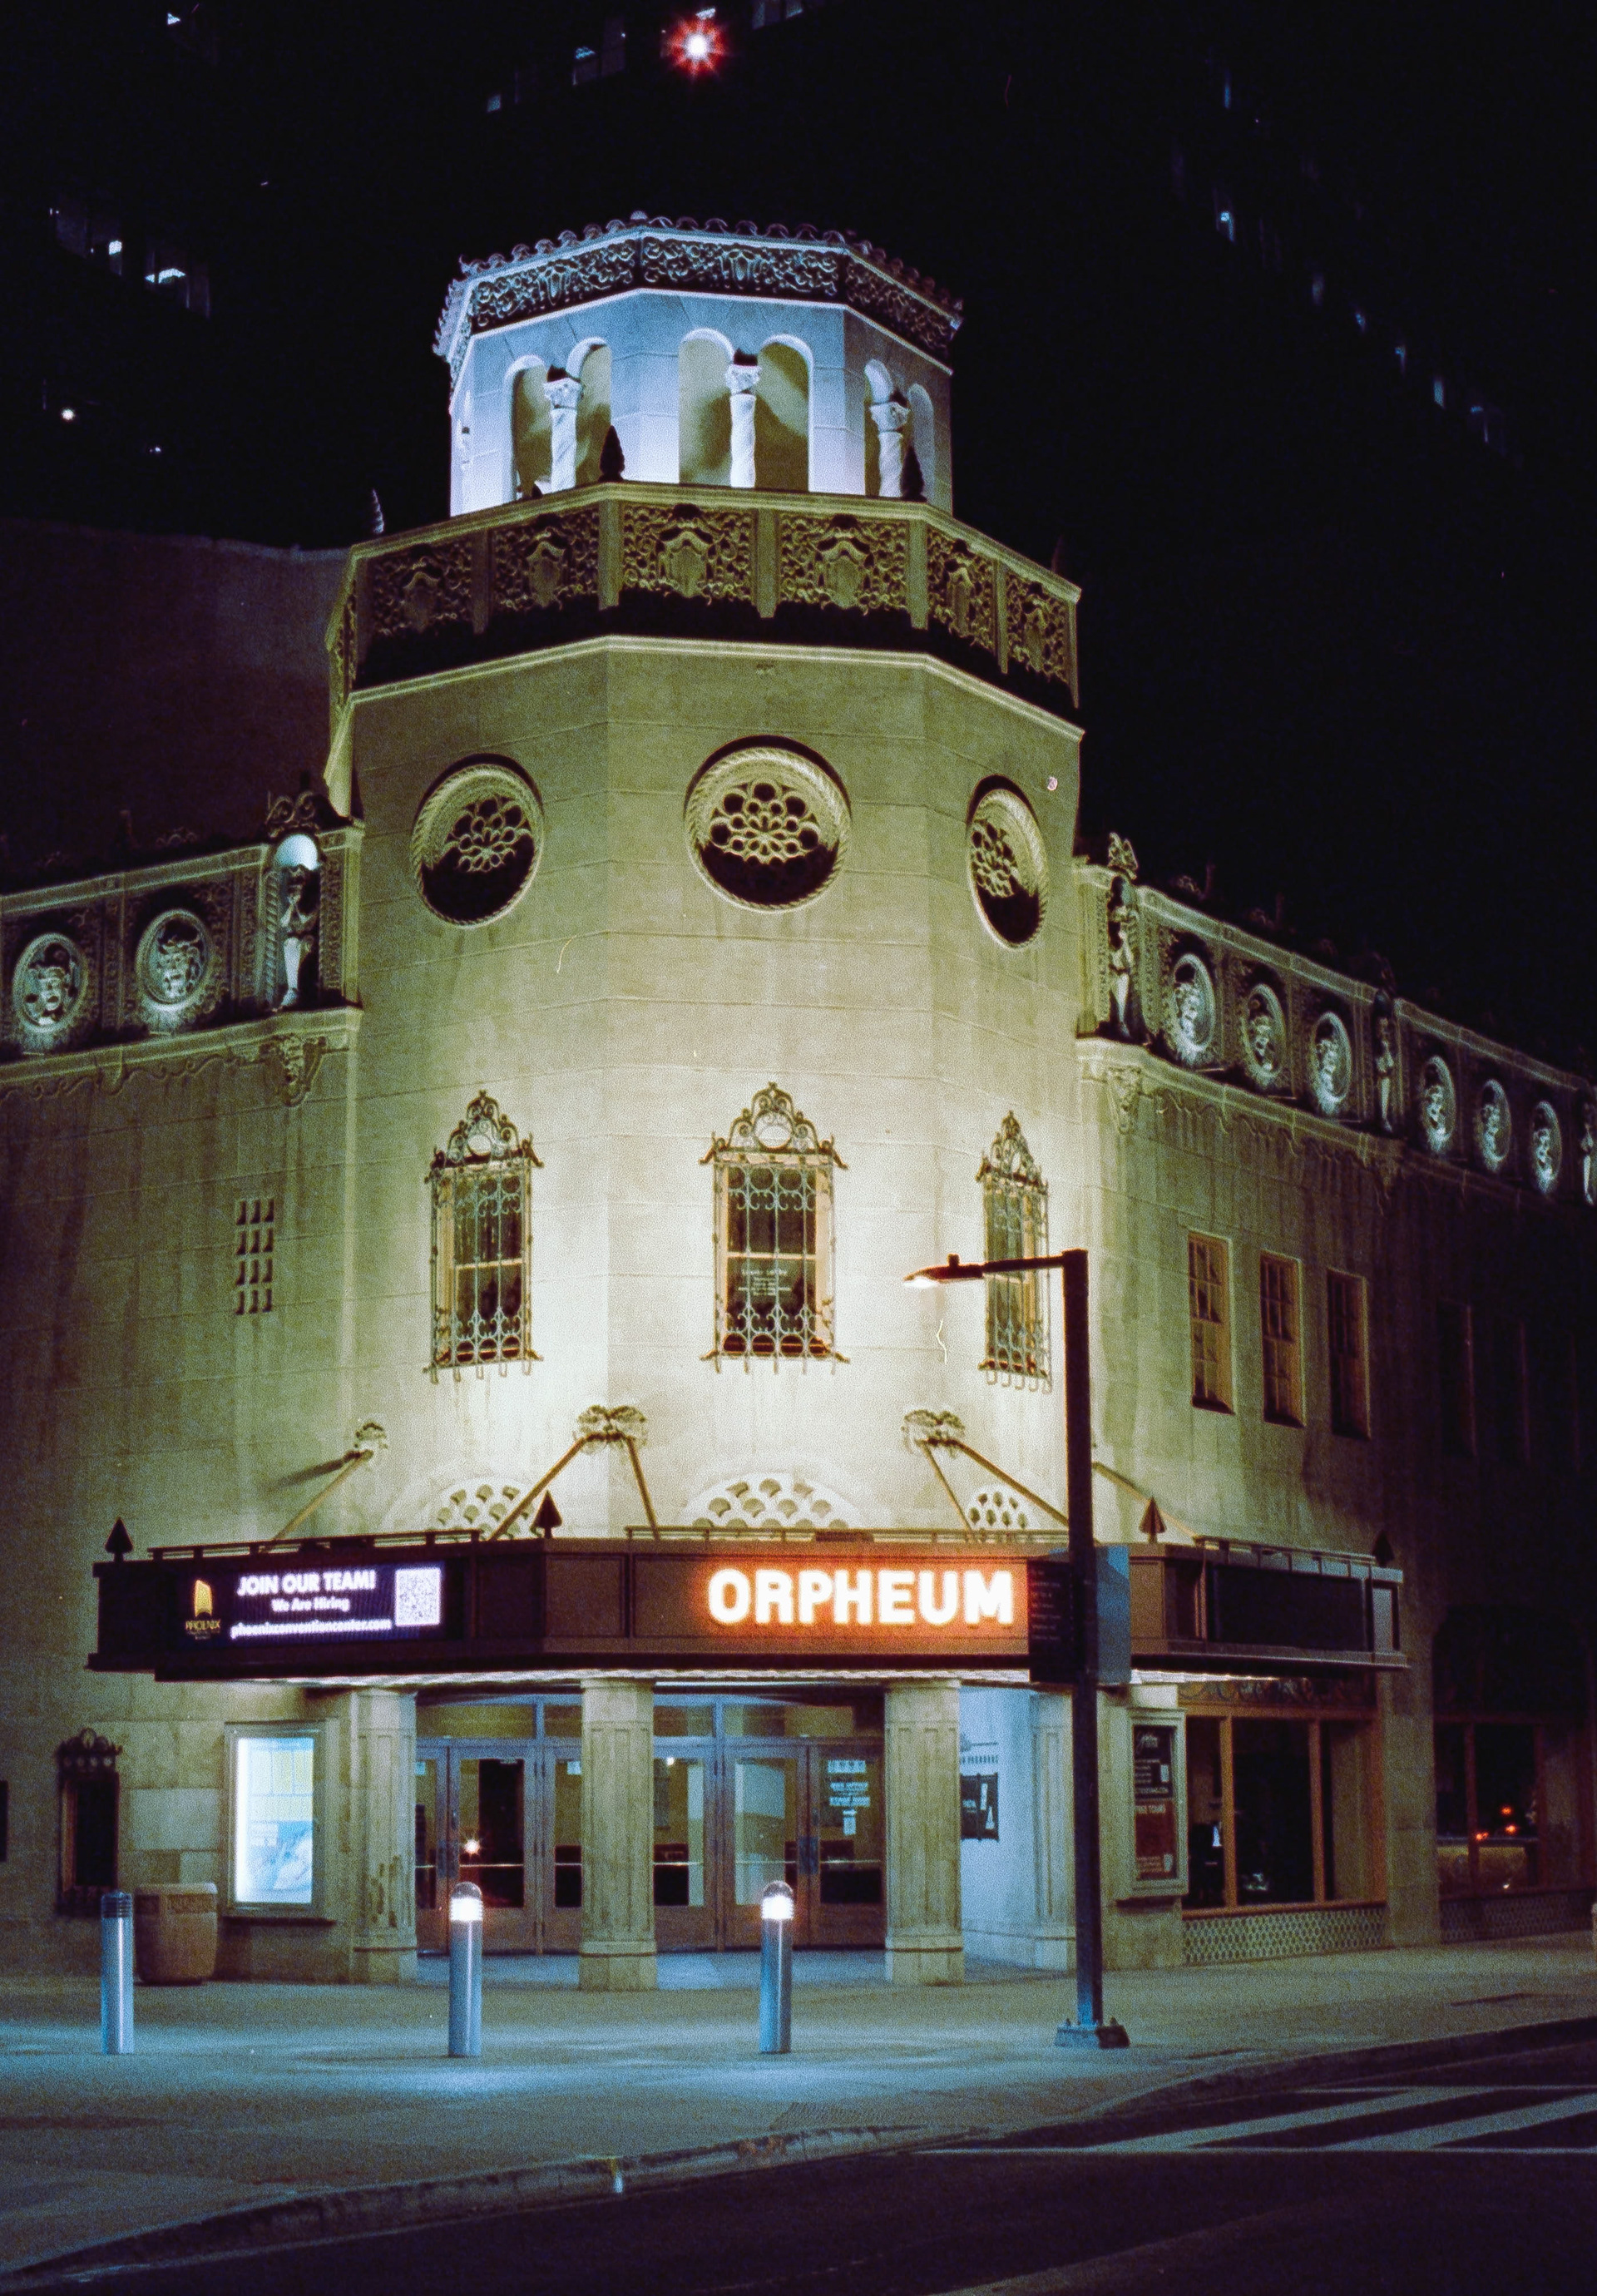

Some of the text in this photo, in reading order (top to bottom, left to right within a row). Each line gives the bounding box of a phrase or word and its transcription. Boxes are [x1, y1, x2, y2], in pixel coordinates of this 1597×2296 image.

[237, 1569, 377, 1596] JOIN OUR TEAM!
[271, 1596, 350, 1612] We Are Hiring
[708, 1568, 1014, 1625] ORPHEUM
